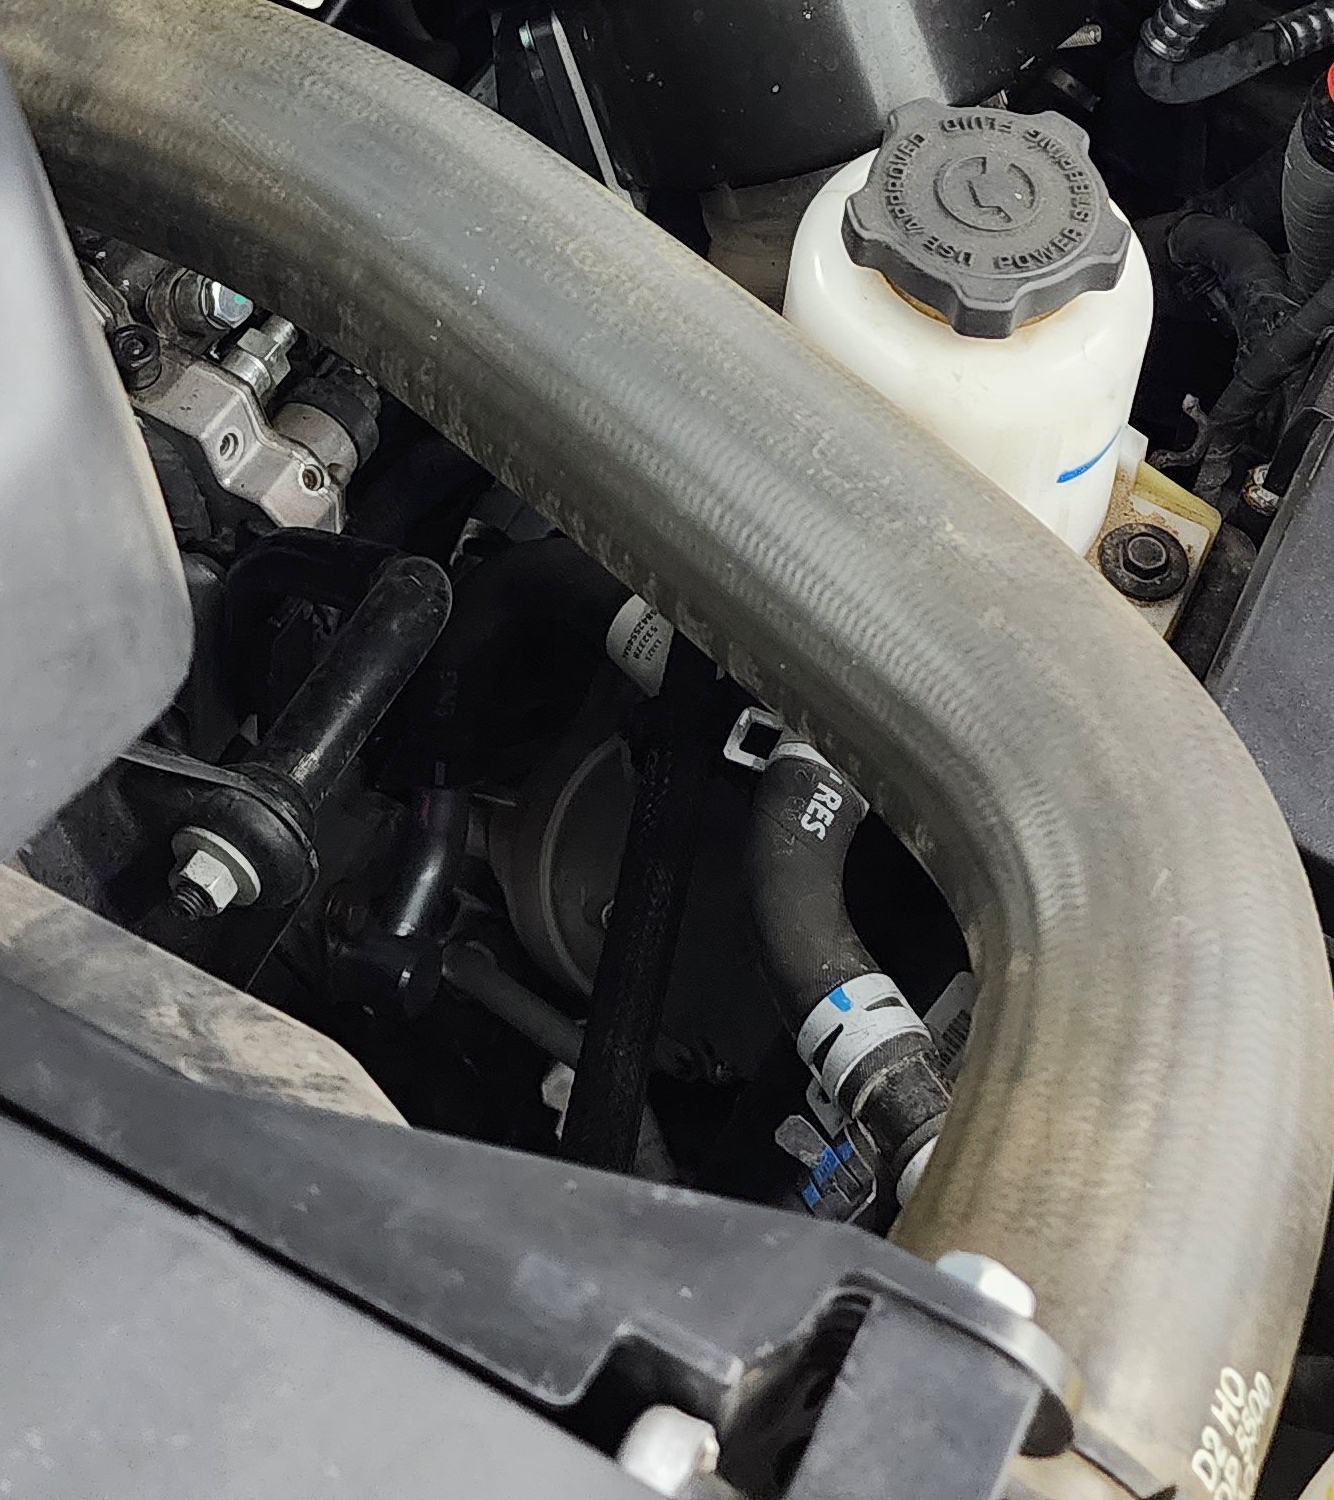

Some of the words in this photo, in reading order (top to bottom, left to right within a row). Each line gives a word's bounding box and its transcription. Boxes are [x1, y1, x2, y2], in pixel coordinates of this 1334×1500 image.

[940, 116, 1013, 134] FLUID
[885, 133, 925, 235] APPROVED
[1022, 129, 1091, 224] STEERING
[921, 235, 977, 268] USE
[993, 227, 1084, 271] POWER
[801, 782, 842, 841] RES
[1192, 1425, 1228, 1493] D2
